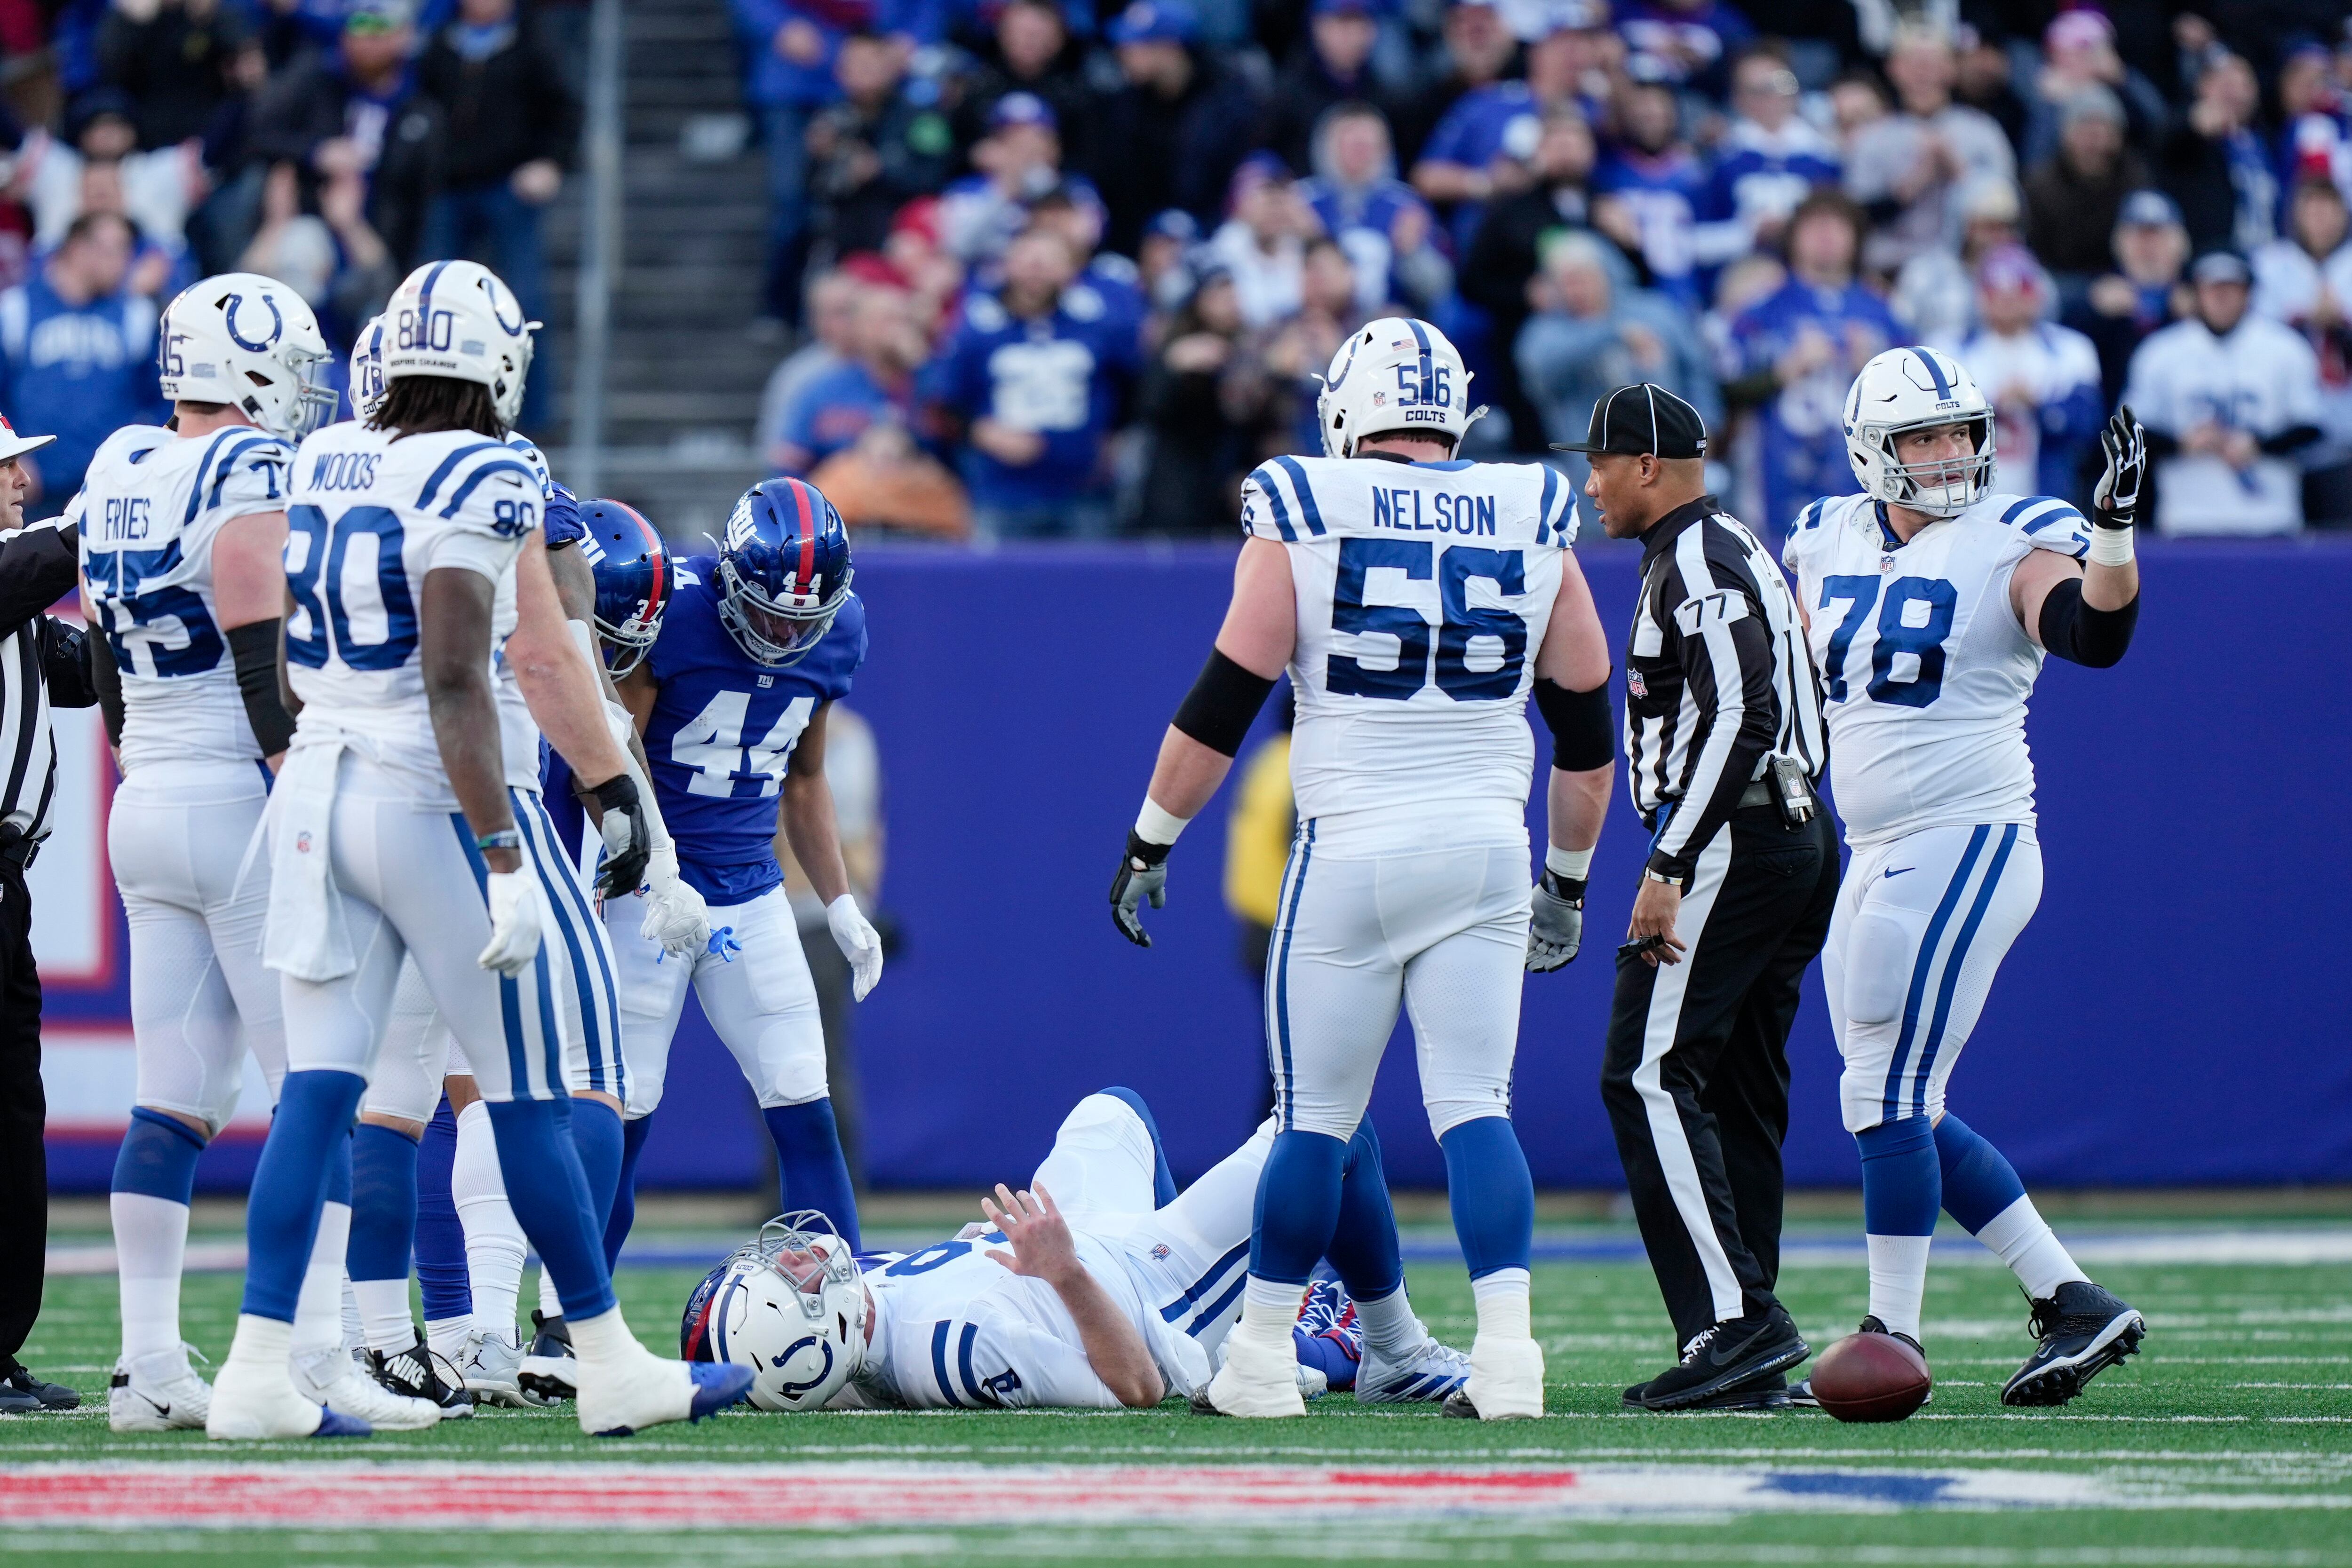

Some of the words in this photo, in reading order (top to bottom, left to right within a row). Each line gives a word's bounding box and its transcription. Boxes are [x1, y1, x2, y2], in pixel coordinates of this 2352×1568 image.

[399, 310, 453, 352] 80
[1398, 365, 1450, 408] 56
[1936, 401, 1960, 411] COLTS
[363, 400, 387, 415] COLT
[1406, 410, 1445, 423] COLTS
[308, 453, 382, 491] WOODS
[106, 498, 151, 540] FRIES
[492, 500, 536, 537] 80
[1373, 486, 1495, 536] NELSON
[286, 505, 418, 670] 80
[783, 571, 822, 594] 44
[81, 538, 225, 677] 75
[631, 599, 666, 621] 37
[1327, 538, 1527, 701] 56
[1684, 592, 1726, 628] 77
[1819, 575, 1958, 708] 78
[671, 690, 816, 799] 44
[384, 1354, 427, 1391] NIKE
